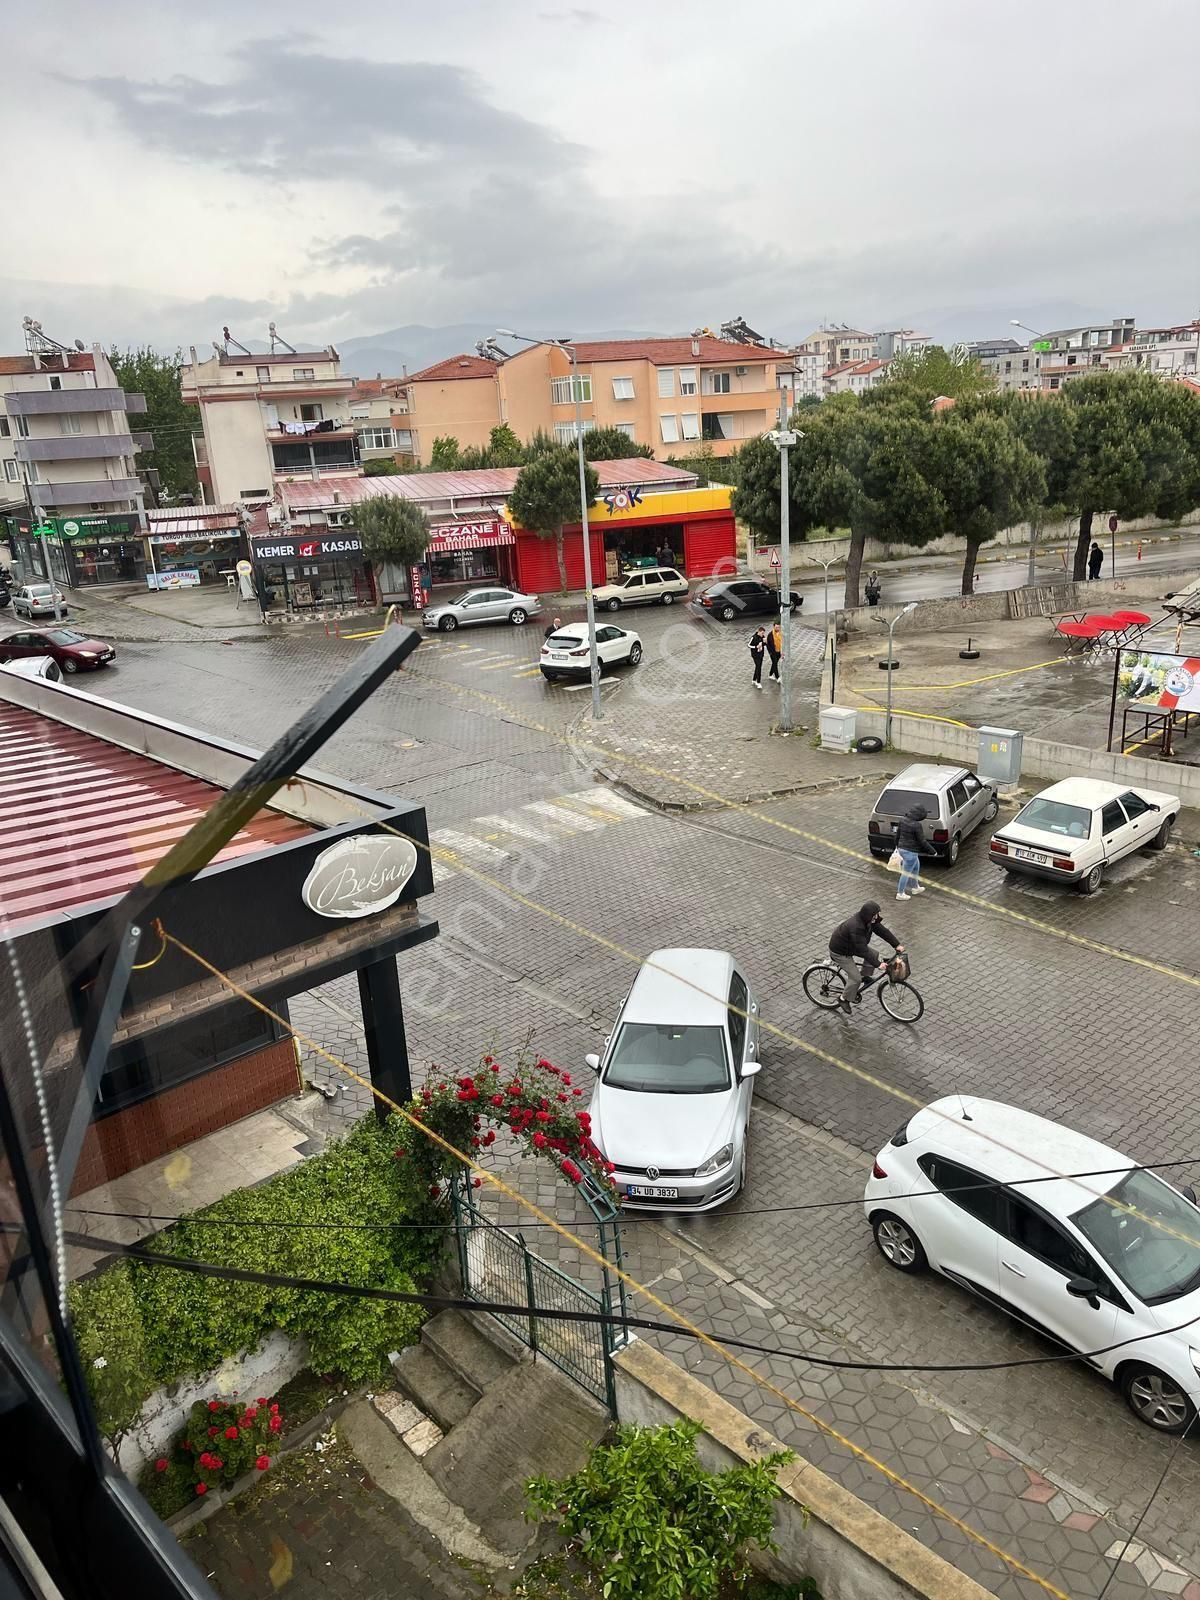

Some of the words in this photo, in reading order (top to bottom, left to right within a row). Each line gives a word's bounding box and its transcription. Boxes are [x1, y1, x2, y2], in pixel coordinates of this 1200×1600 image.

[603, 485, 642, 517] ŞOK
[429, 524, 494, 539] ECZANE
[446, 534, 479, 543] BAHAR
[256, 545, 295, 558] KEMER
[321, 539, 363, 553] KASABI
[412, 567, 423, 609] ECZANE
[317, 846, 409, 908] Beksan
[632, 1187, 641, 1195] 34
[645, 1187, 654, 1195] UD
[657, 1188, 676, 1197] 3832
